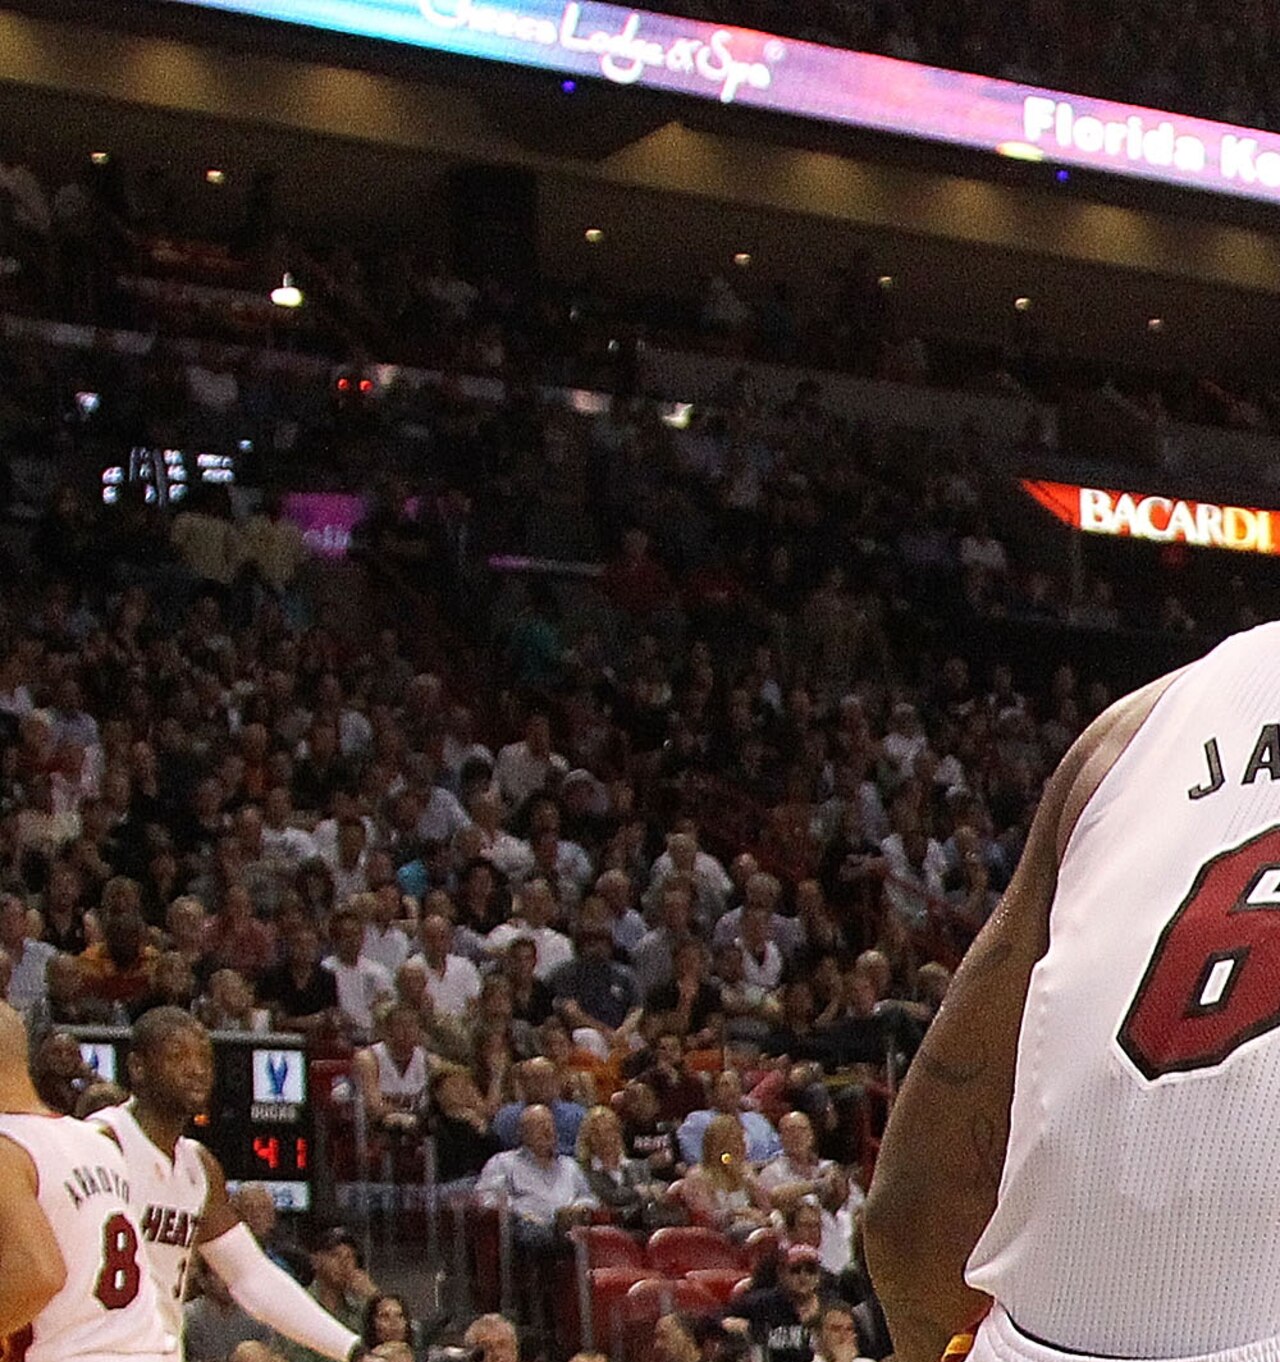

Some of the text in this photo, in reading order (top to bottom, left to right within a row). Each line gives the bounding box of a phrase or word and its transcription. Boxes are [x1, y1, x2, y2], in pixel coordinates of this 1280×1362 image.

[1024, 95, 1206, 171] Florida
[1080, 488, 1275, 554] BACARDI
[253, 1137, 308, 1169] 41
[94, 1210, 140, 1311] 8
